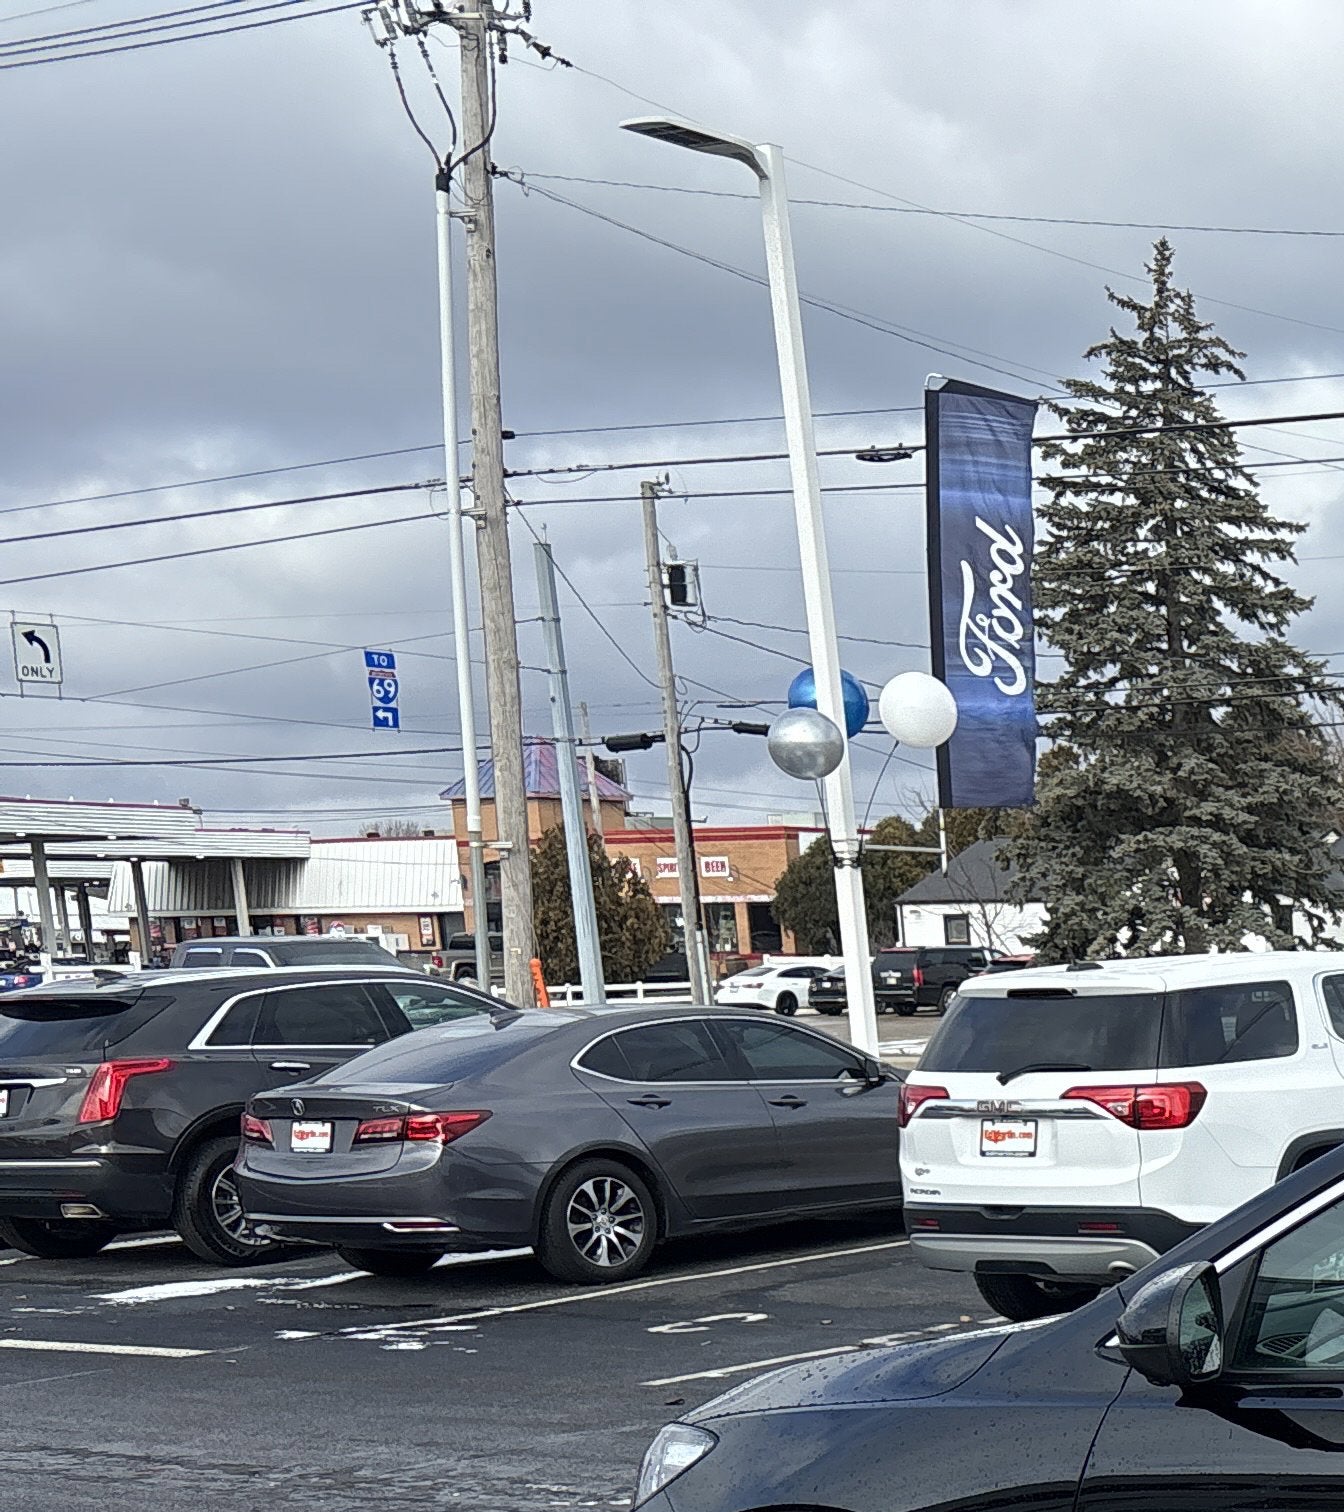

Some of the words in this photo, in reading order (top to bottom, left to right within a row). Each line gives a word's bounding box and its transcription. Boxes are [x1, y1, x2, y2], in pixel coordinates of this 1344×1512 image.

[960, 516, 1026, 695] Ford
[371, 654, 388, 667] TO
[21, 665, 55, 678] ONLY
[373, 679, 396, 698] 69
[704, 861, 727, 873] BEER
[373, 1105, 400, 1113] TLX
[977, 1100, 1023, 1112] GMC
